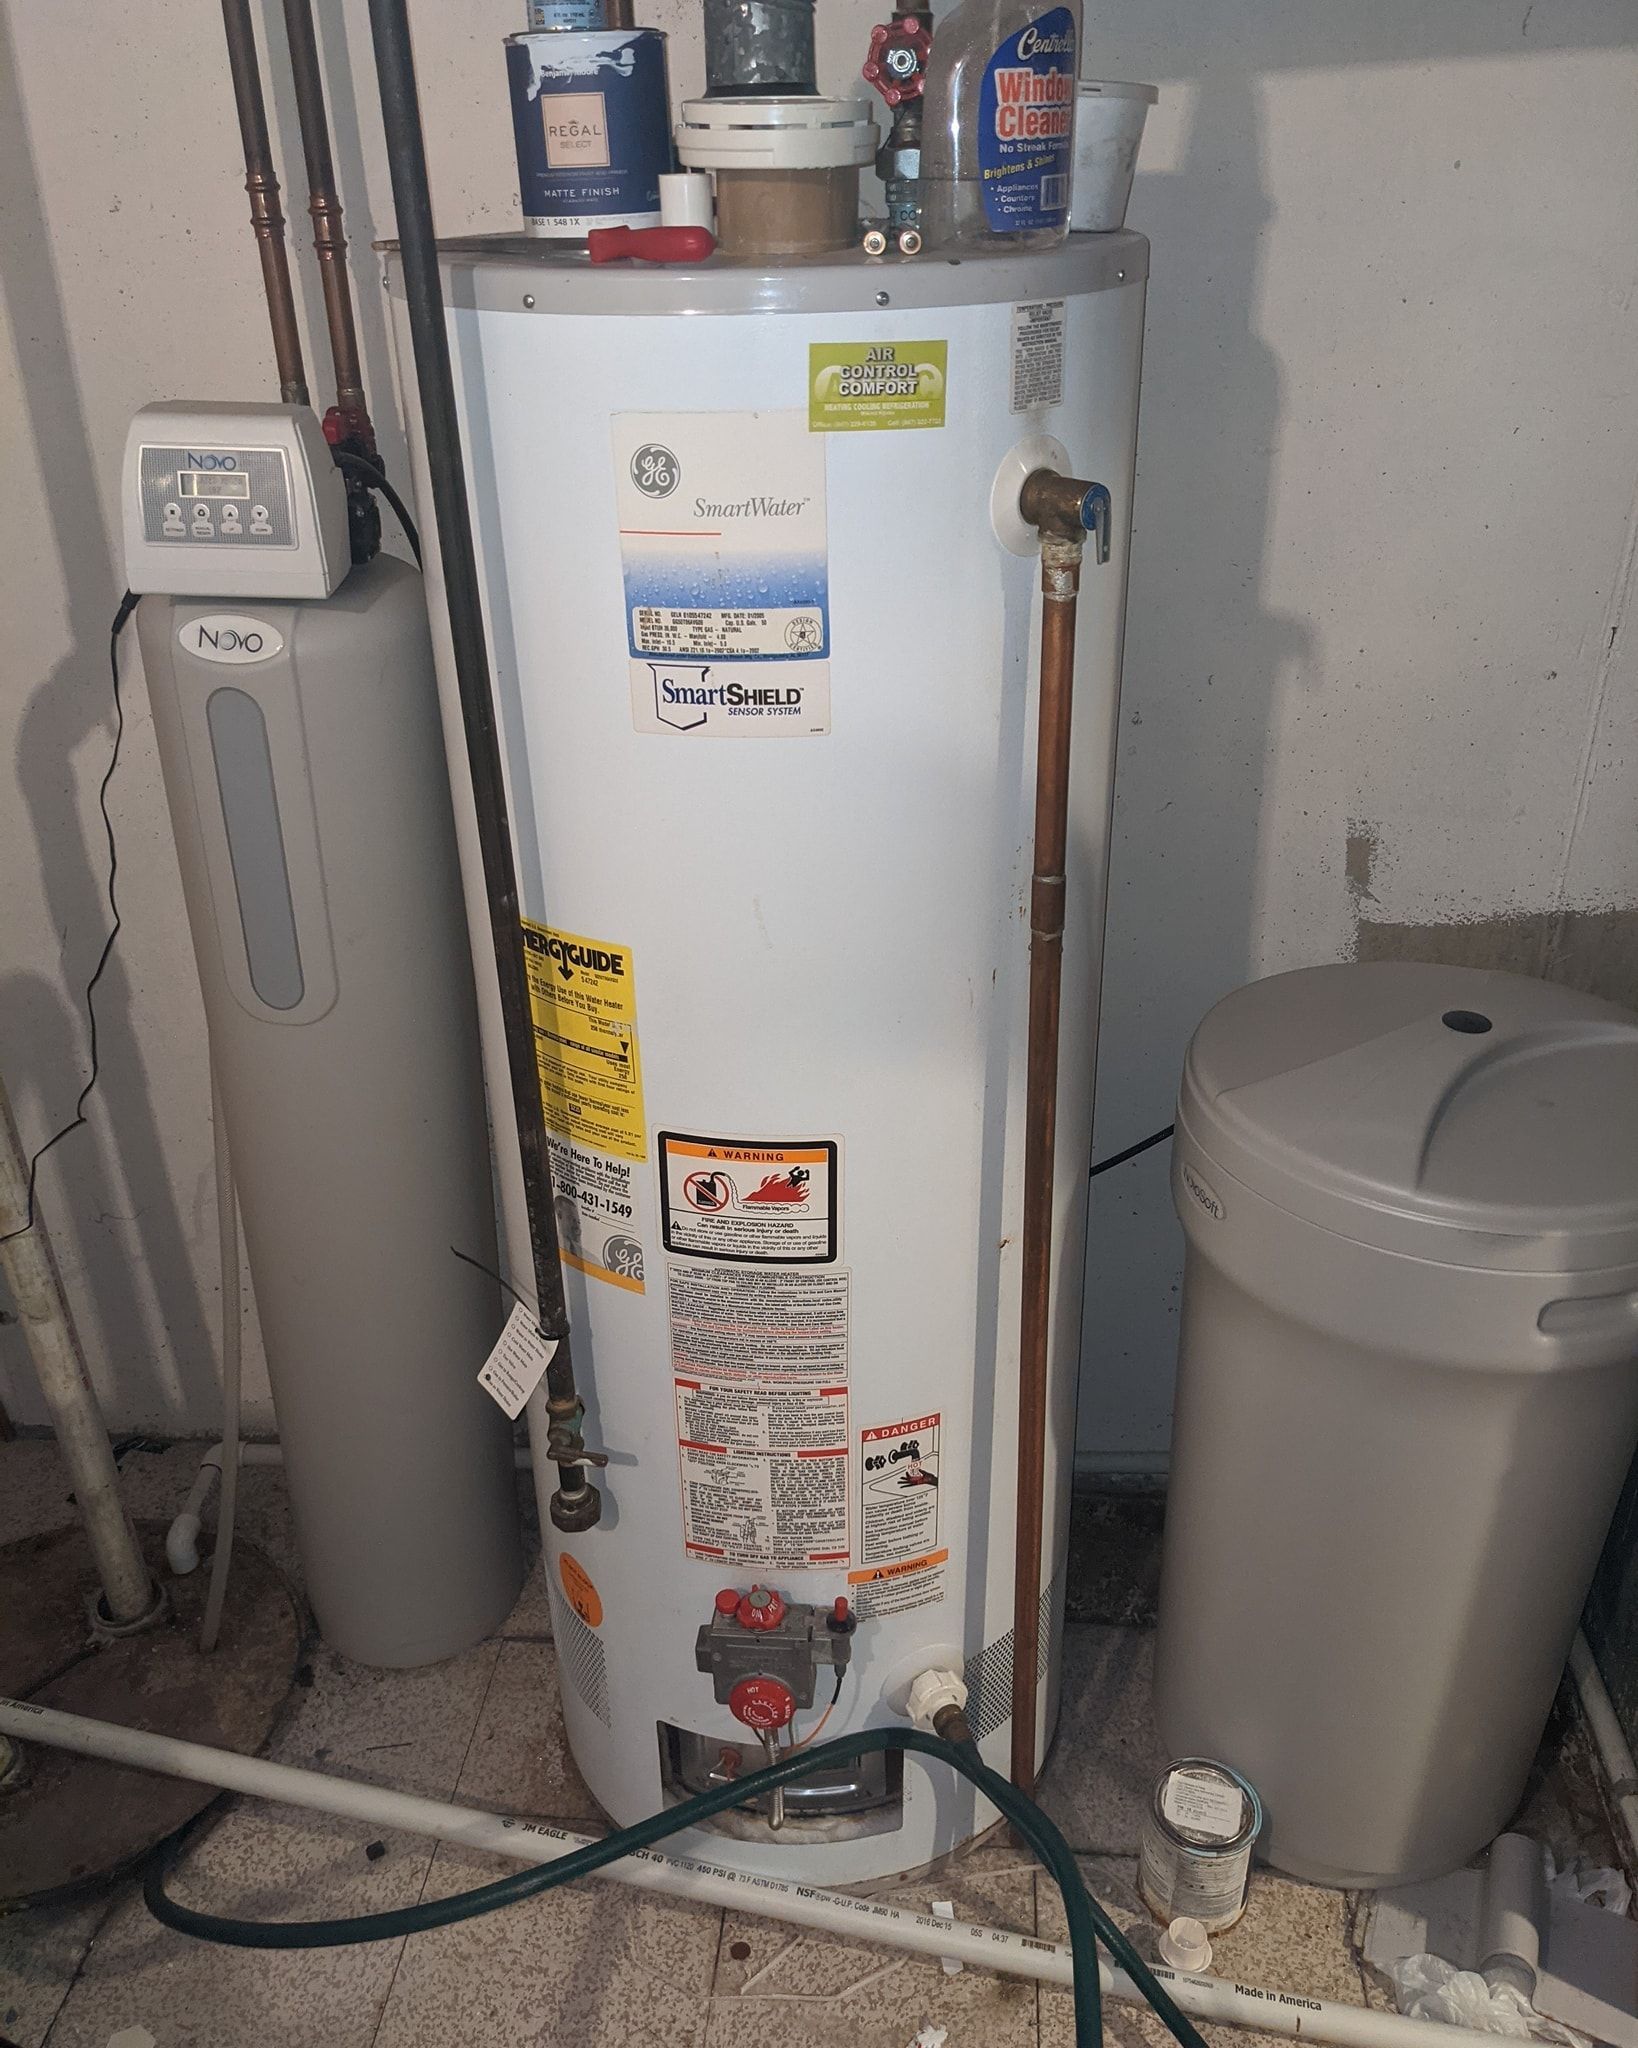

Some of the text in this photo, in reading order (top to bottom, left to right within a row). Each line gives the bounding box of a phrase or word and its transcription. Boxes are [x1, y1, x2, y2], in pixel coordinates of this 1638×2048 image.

[549, 124, 602, 137] REGAL
[560, 140, 592, 149] SELECT
[1000, 142, 1046, 153] No Streak
[984, 163, 1025, 180] Brightens
[1027, 160, 1033, 170] &
[544, 187, 620, 198] MATTE FINISH
[1001, 195, 1035, 203] Counters
[1003, 205, 1032, 213] Chrome
[866, 347, 894, 362] AIR
[840, 364, 918, 379] CONTROL
[839, 381, 918, 396] COMFORT
[854, 402, 880, 411] COOLING
[728, 706, 801, 716] SENSOR SYSTEM
[540, 978, 556, 992] Energy
[557, 985, 567, 995] Use
[568, 989, 574, 997] of
[574, 989, 584, 1000] this
[586, 994, 602, 1006] Water
[604, 998, 623, 1010] Heater
[558, 994, 574, 1006] Before
[575, 999, 585, 1009] You
[546, 1136, 631, 1179] We're Here To Help!
[723, 1150, 784, 1161] WARNING
[551, 1175, 632, 1218] 1-800-431-1549
[731, 1220, 766, 1228] EXPLOSION
[881, 1417, 936, 1438] DANGER
[908, 1460, 923, 1469] HOT
[886, 1559, 928, 1576] WARNING
[747, 1686, 759, 1695] HOT
[522, 1823, 568, 1840] JM EAGLE
[651, 1853, 664, 1864] 40
[681, 1861, 694, 1871] 1120
[697, 1864, 711, 1875] 450
[712, 1868, 726, 1879] PSI
[727, 1871, 736, 1882] @
[752, 1878, 769, 1888] ASTM
[854, 1902, 870, 1912] Code
[890, 1910, 900, 1920] HA
[916, 1915, 930, 1927] 2016
[931, 1918, 944, 1929] Dec
[1235, 1984, 1322, 2012] Made in America
